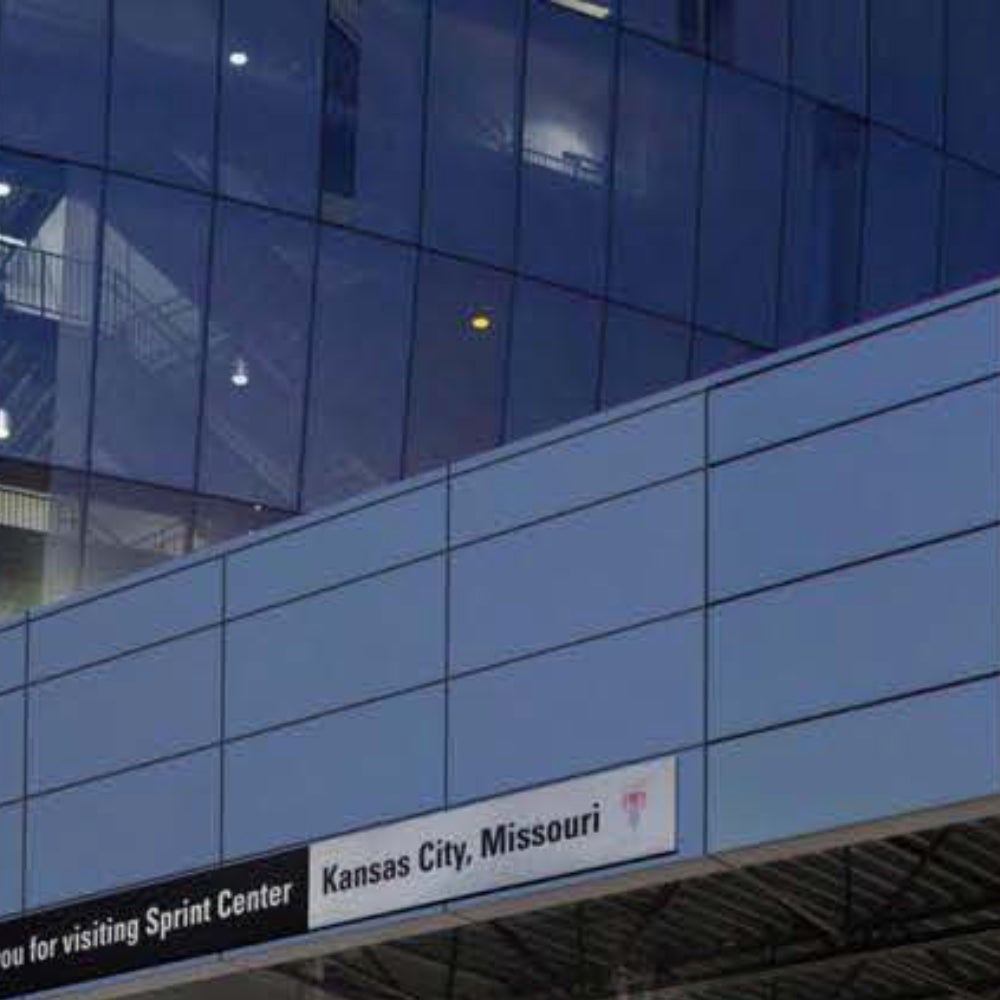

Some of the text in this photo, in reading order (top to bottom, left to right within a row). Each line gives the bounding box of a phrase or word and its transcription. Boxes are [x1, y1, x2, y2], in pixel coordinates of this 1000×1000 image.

[322, 802, 600, 895] Kansas City, Missouri
[0, 882, 293, 969] ou for visiting Sprint Center
